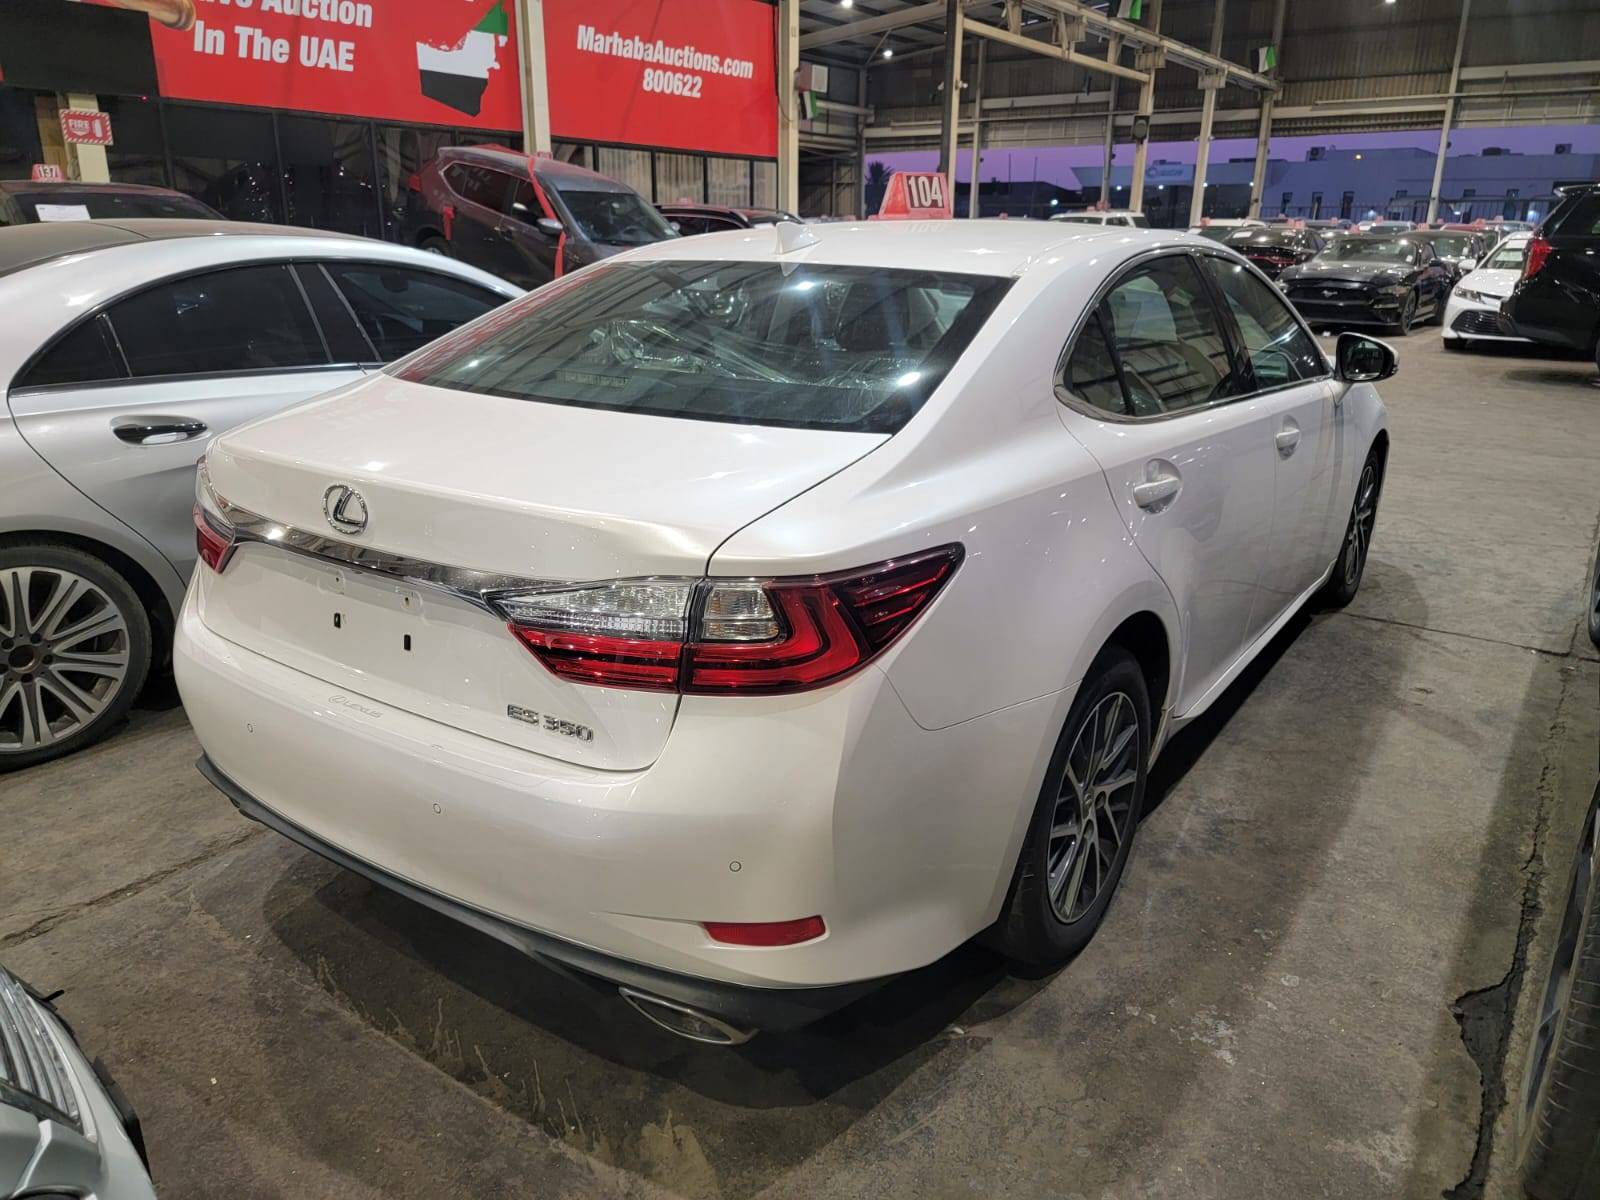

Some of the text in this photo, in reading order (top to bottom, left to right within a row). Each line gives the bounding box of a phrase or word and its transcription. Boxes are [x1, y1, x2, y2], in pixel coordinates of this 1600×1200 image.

[193, 20, 355, 71] In The UAE
[577, 24, 753, 79] MarhabaAuctions.com
[642, 68, 702, 98] 800622
[908, 176, 943, 208] 104
[507, 704, 594, 742] ES 350
